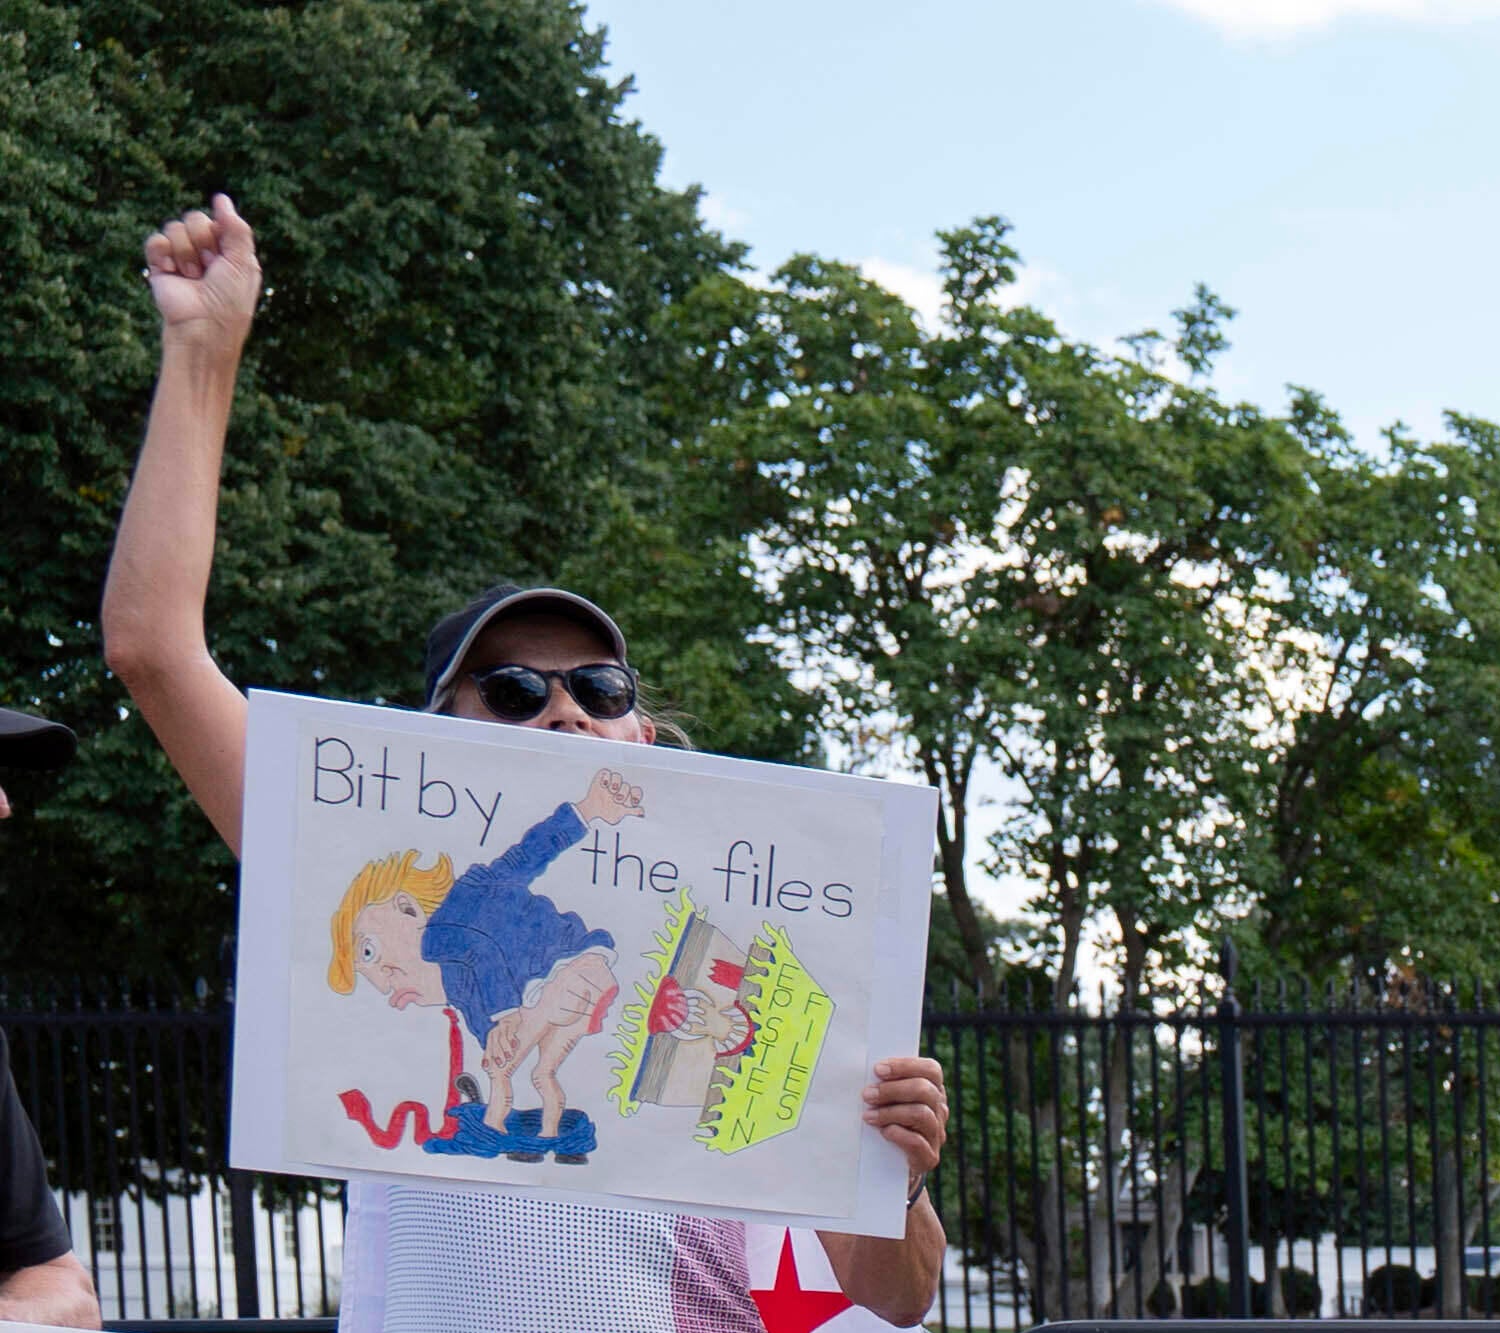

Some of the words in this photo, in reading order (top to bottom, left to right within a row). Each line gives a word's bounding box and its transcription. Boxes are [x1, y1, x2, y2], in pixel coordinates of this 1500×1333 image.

[312, 736, 401, 811] Bit
[419, 752, 502, 846] by
[581, 829, 678, 894] the
[712, 840, 853, 919] files
[731, 962, 800, 1144] EPSTEIN
[776, 991, 829, 1121] FILES
